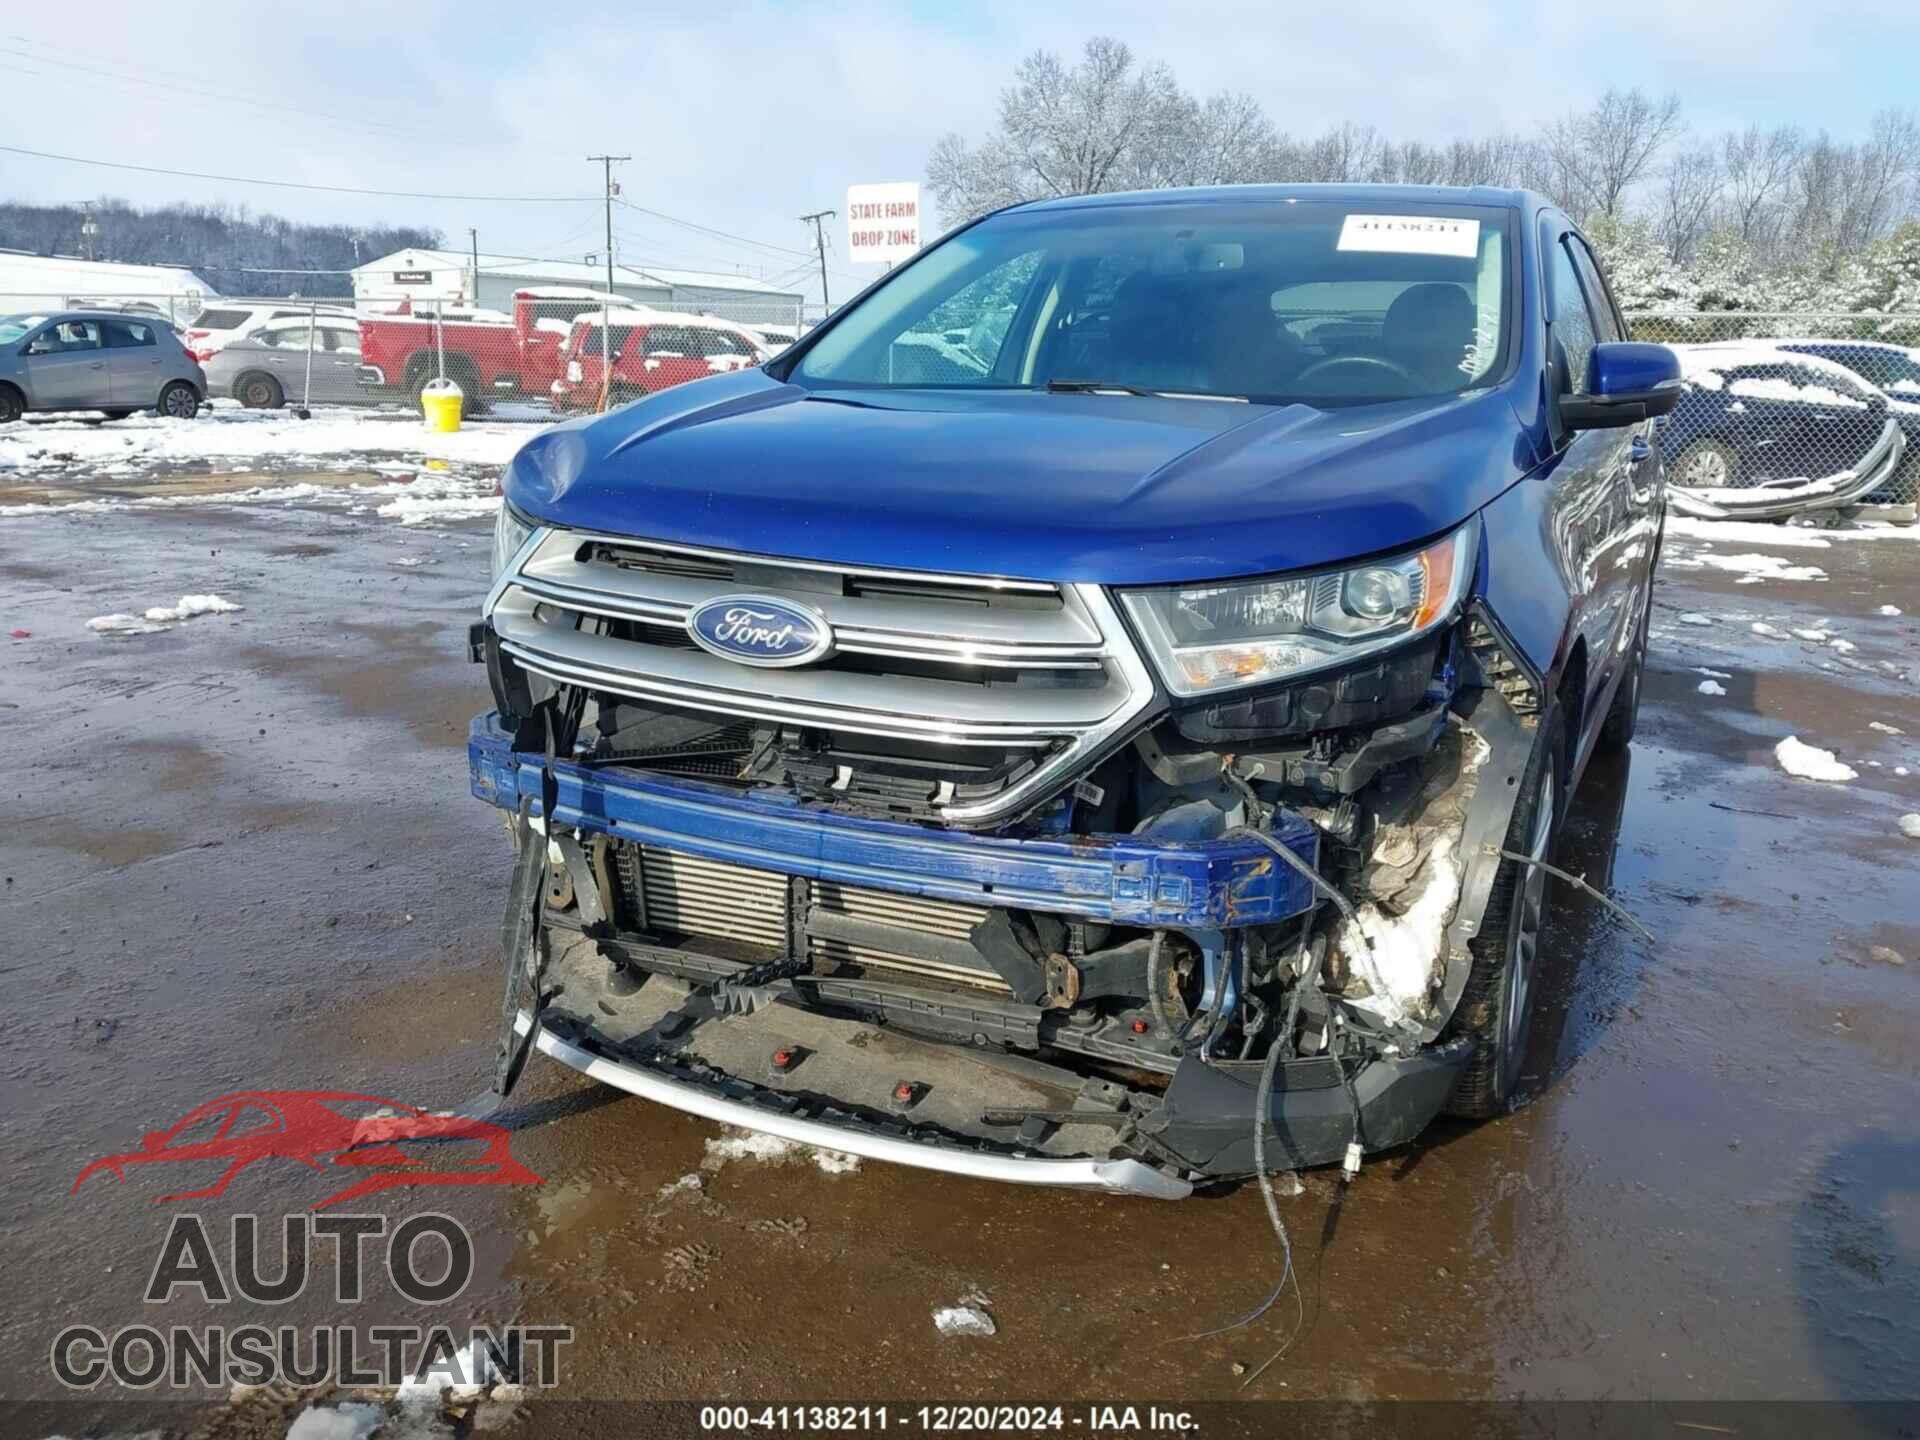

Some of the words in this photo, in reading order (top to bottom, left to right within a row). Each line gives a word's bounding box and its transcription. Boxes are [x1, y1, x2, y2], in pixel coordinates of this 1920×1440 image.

[850, 203, 882, 219] STATE
[885, 202, 915, 217] FARM
[852, 230, 883, 246] DROP
[887, 229, 917, 245] ZONE
[715, 608, 792, 649] Ford
